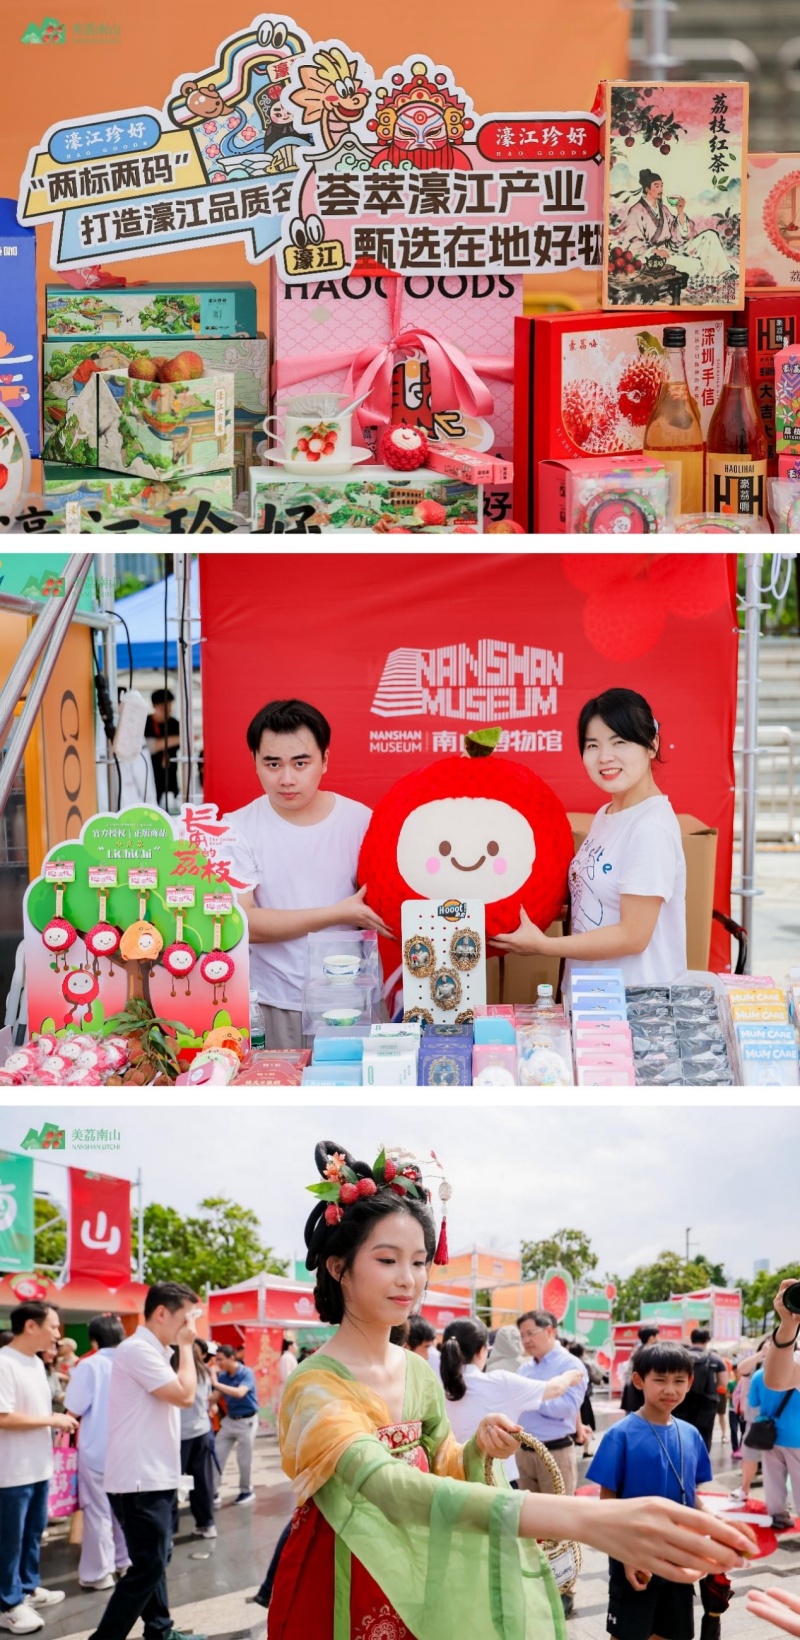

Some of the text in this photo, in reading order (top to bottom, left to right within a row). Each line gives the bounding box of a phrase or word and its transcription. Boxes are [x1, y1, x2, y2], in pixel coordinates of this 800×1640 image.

[64, 121, 147, 151] 濠江珍好
[496, 126, 587, 148] 濠江珍好
[708, 93, 730, 173] 荔枝红茶
[317, 169, 586, 216] 荟萃濠江产业
[293, 246, 338, 270] 濠江
[701, 327, 716, 407] 深圳手信
[724, 464, 755, 474] HAOLIHAI
[416, 638, 564, 687] NANSHAN
[421, 686, 558, 722] MUSEUM
[369, 730, 422, 741] NANSHAN
[432, 729, 563, 752] 南物馆
[369, 742, 422, 753] MUSEUM
[731, 993, 779, 1003] MUM CARE
[735, 1010, 785, 1020] MUM CARE
[740, 1029, 792, 1039] MUM CARE
[745, 1049, 797, 1059] MUM CARE
[81, 1211, 121, 1255] 山
